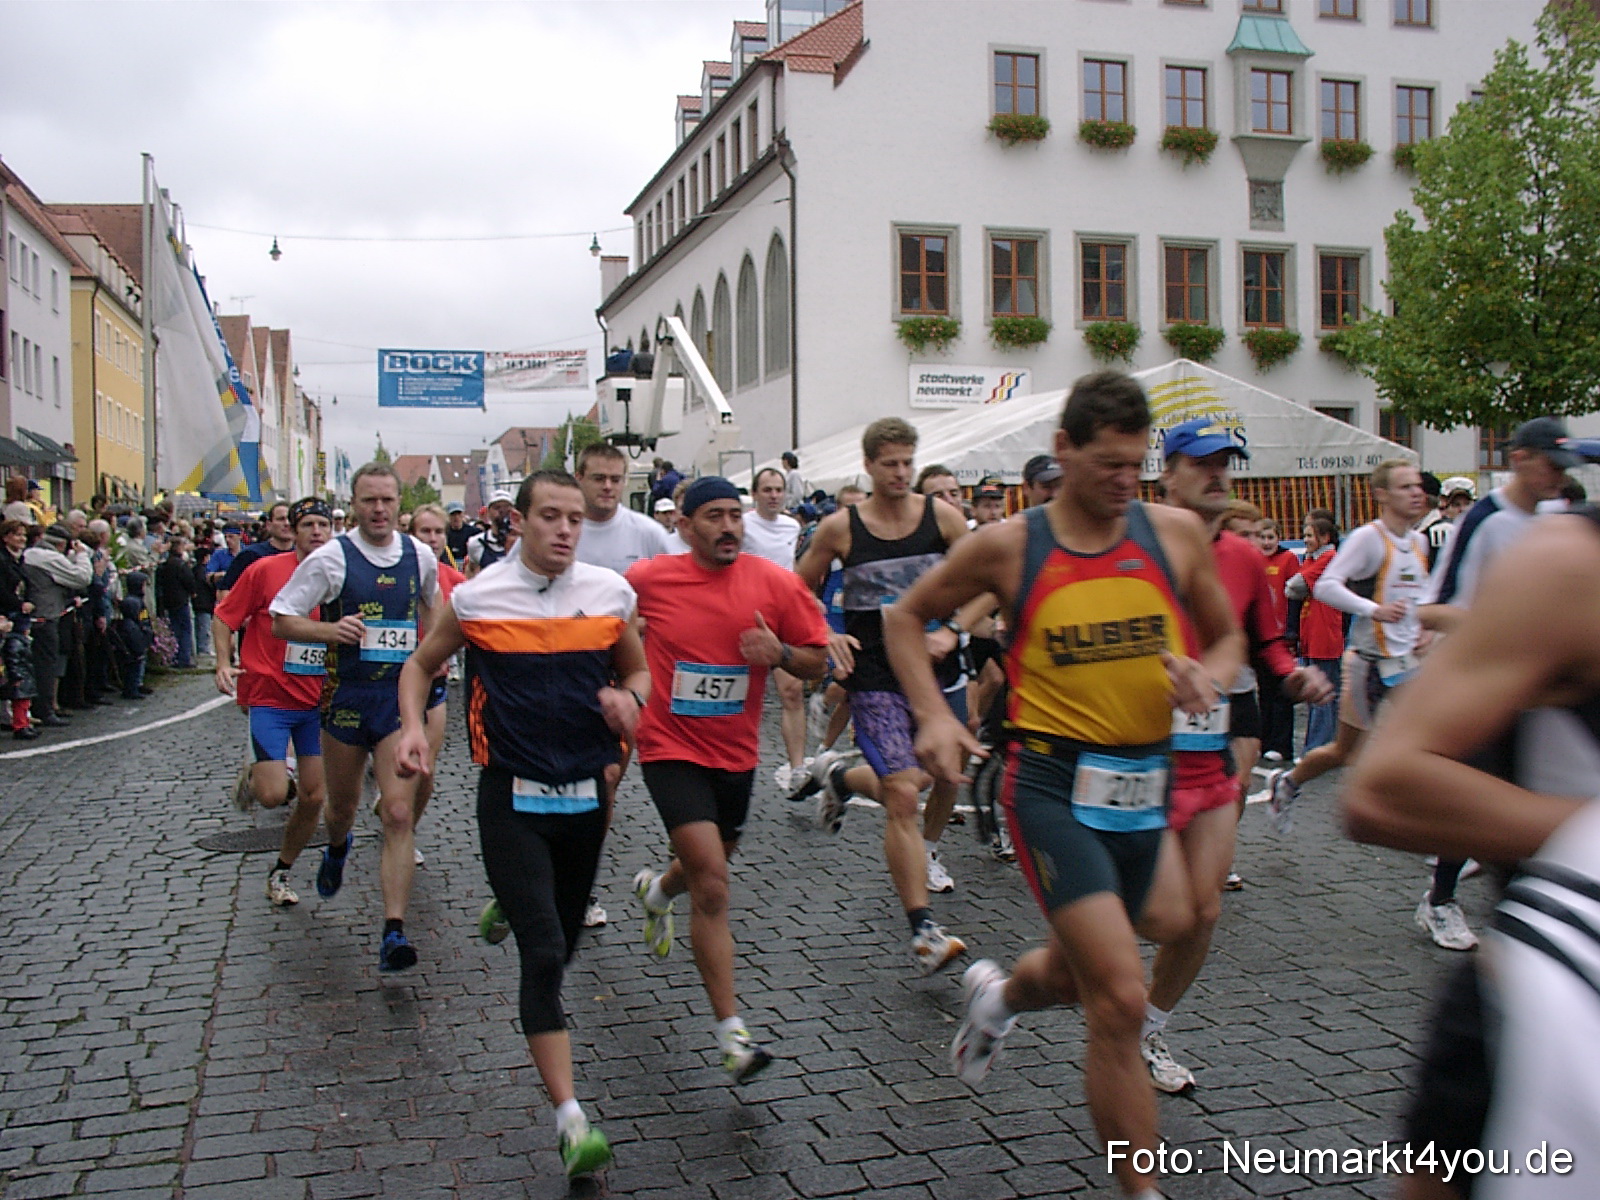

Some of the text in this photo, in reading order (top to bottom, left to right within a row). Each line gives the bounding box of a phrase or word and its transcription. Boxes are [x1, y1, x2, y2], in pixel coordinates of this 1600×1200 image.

[383, 352, 478, 374] BOCK
[919, 373, 985, 385] stadtwerke
[917, 386, 972, 397] neumarkt
[1296, 456, 1319, 469] Tel:
[1321, 455, 1355, 469] 09180
[378, 629, 407, 648] 434
[1041, 614, 1167, 652] HUBER
[300, 648, 327, 665] 459
[694, 677, 736, 699] 457
